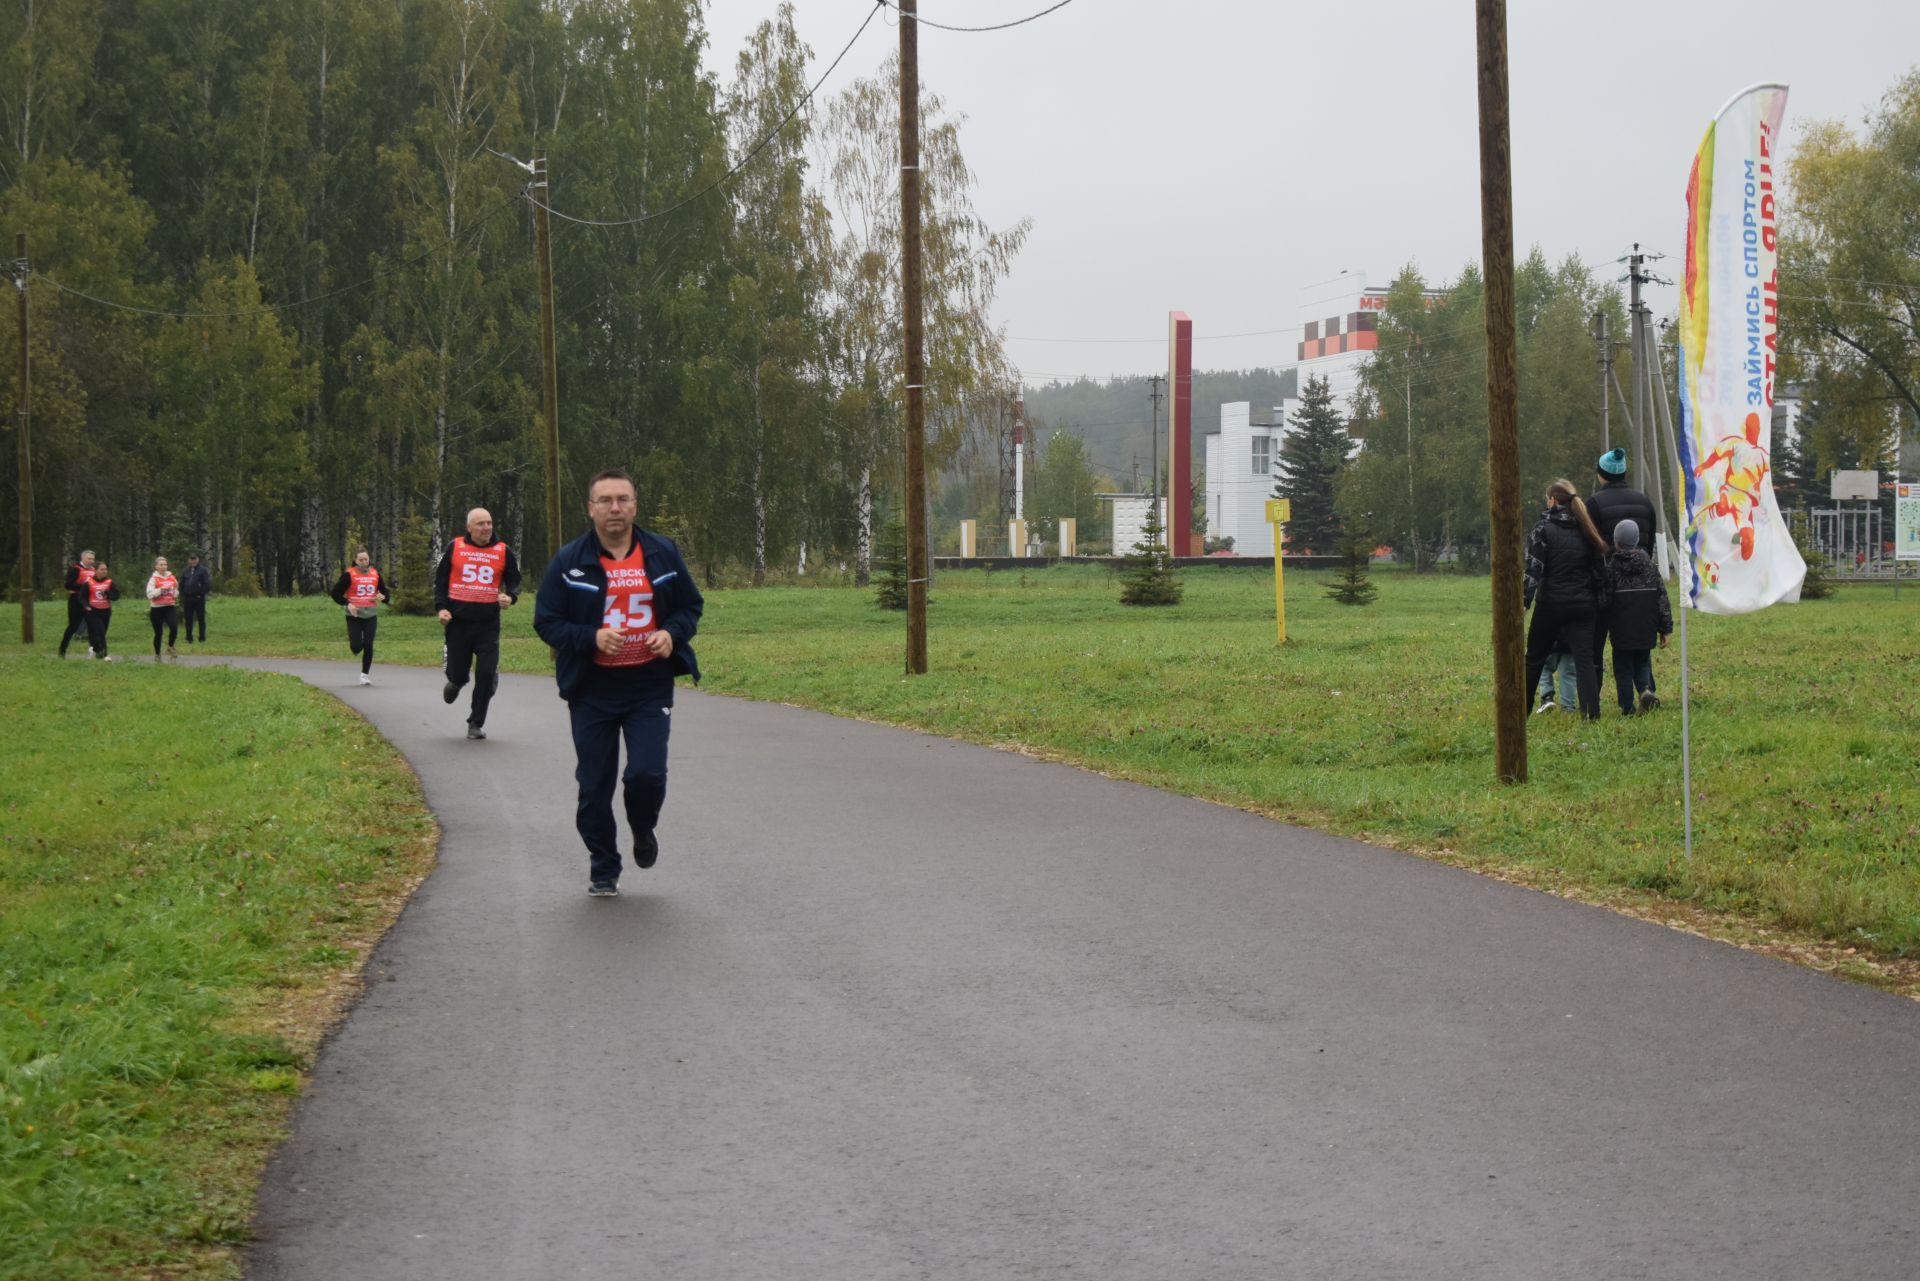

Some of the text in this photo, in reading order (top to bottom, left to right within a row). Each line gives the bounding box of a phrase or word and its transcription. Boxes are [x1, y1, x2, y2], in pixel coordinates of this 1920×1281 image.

[1742, 160, 1762, 406] ЗАЙМИСЬ СПОРТОМ
[461, 563, 495, 584] 58
[608, 578, 643, 588] АЙОН
[357, 584, 376, 597] 59
[603, 592, 654, 629] 45
